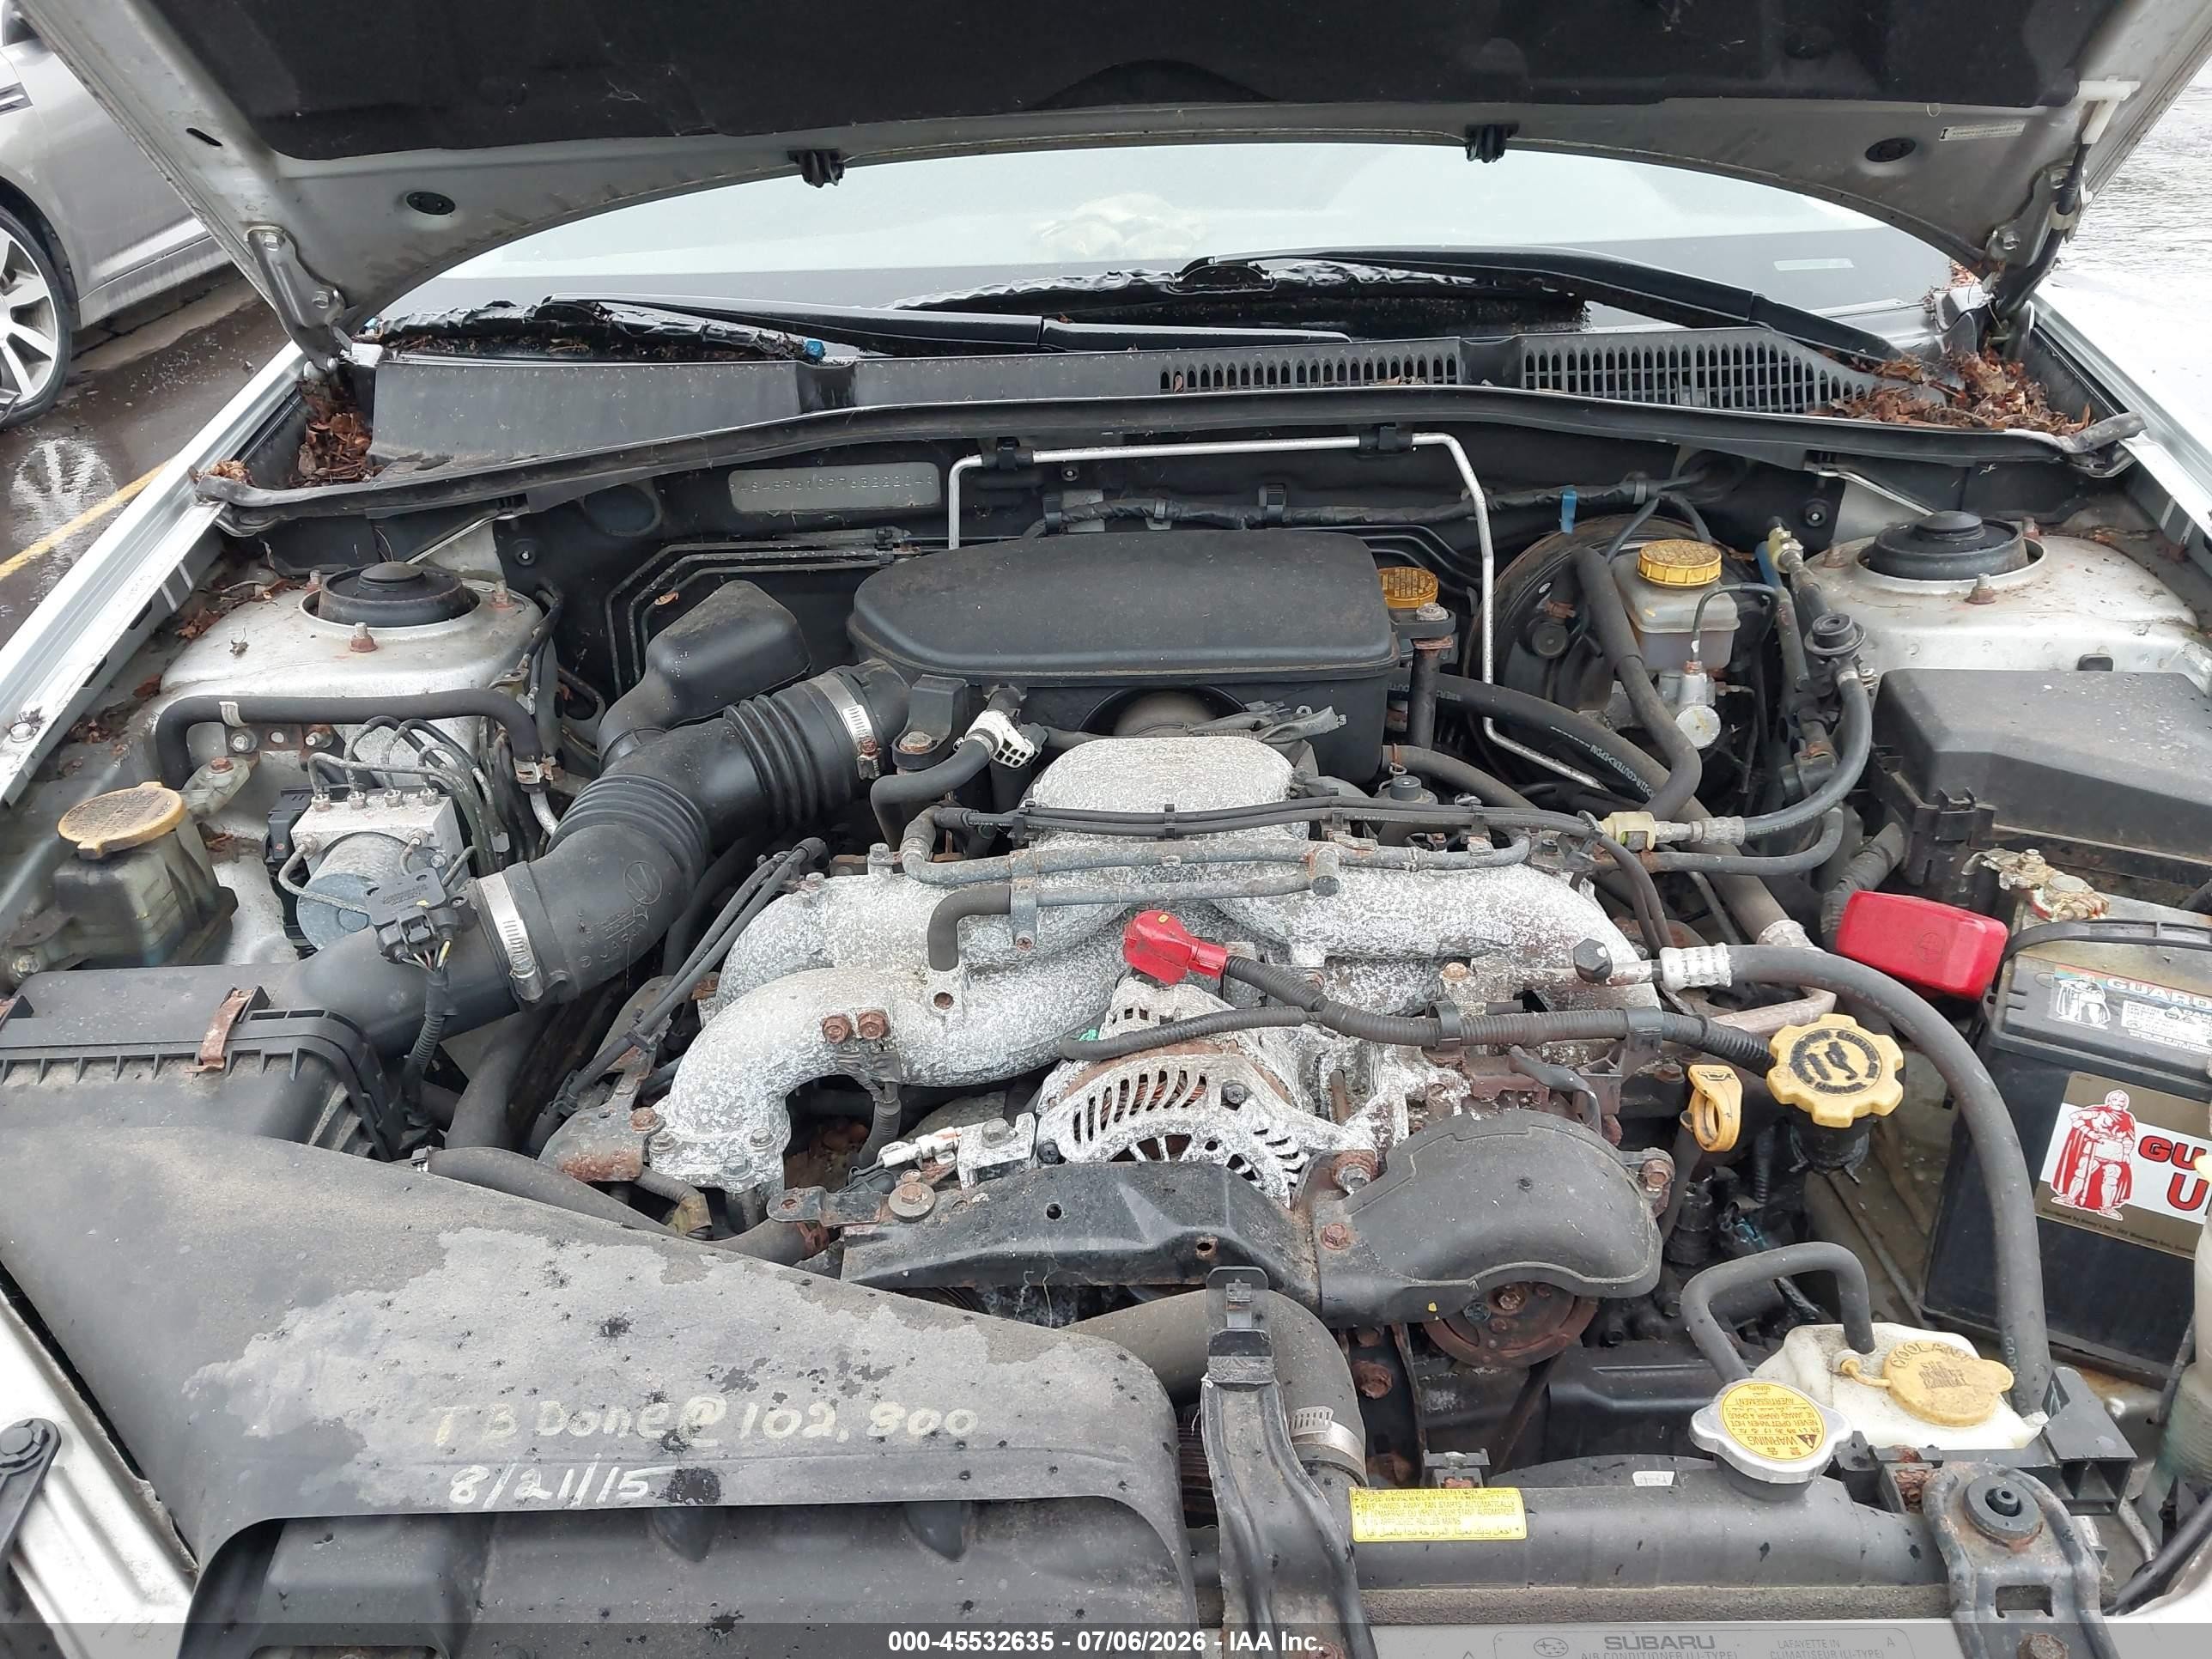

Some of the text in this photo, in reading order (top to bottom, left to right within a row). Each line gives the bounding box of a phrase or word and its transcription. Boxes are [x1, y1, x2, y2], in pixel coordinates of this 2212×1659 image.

[2166, 1173, 2212, 1216] U
[1747, 1436, 1797, 1446] WARNING
[447, 1453, 683, 1510] 8/21/15
[1604, 1635, 1716, 1650] SUBARU
